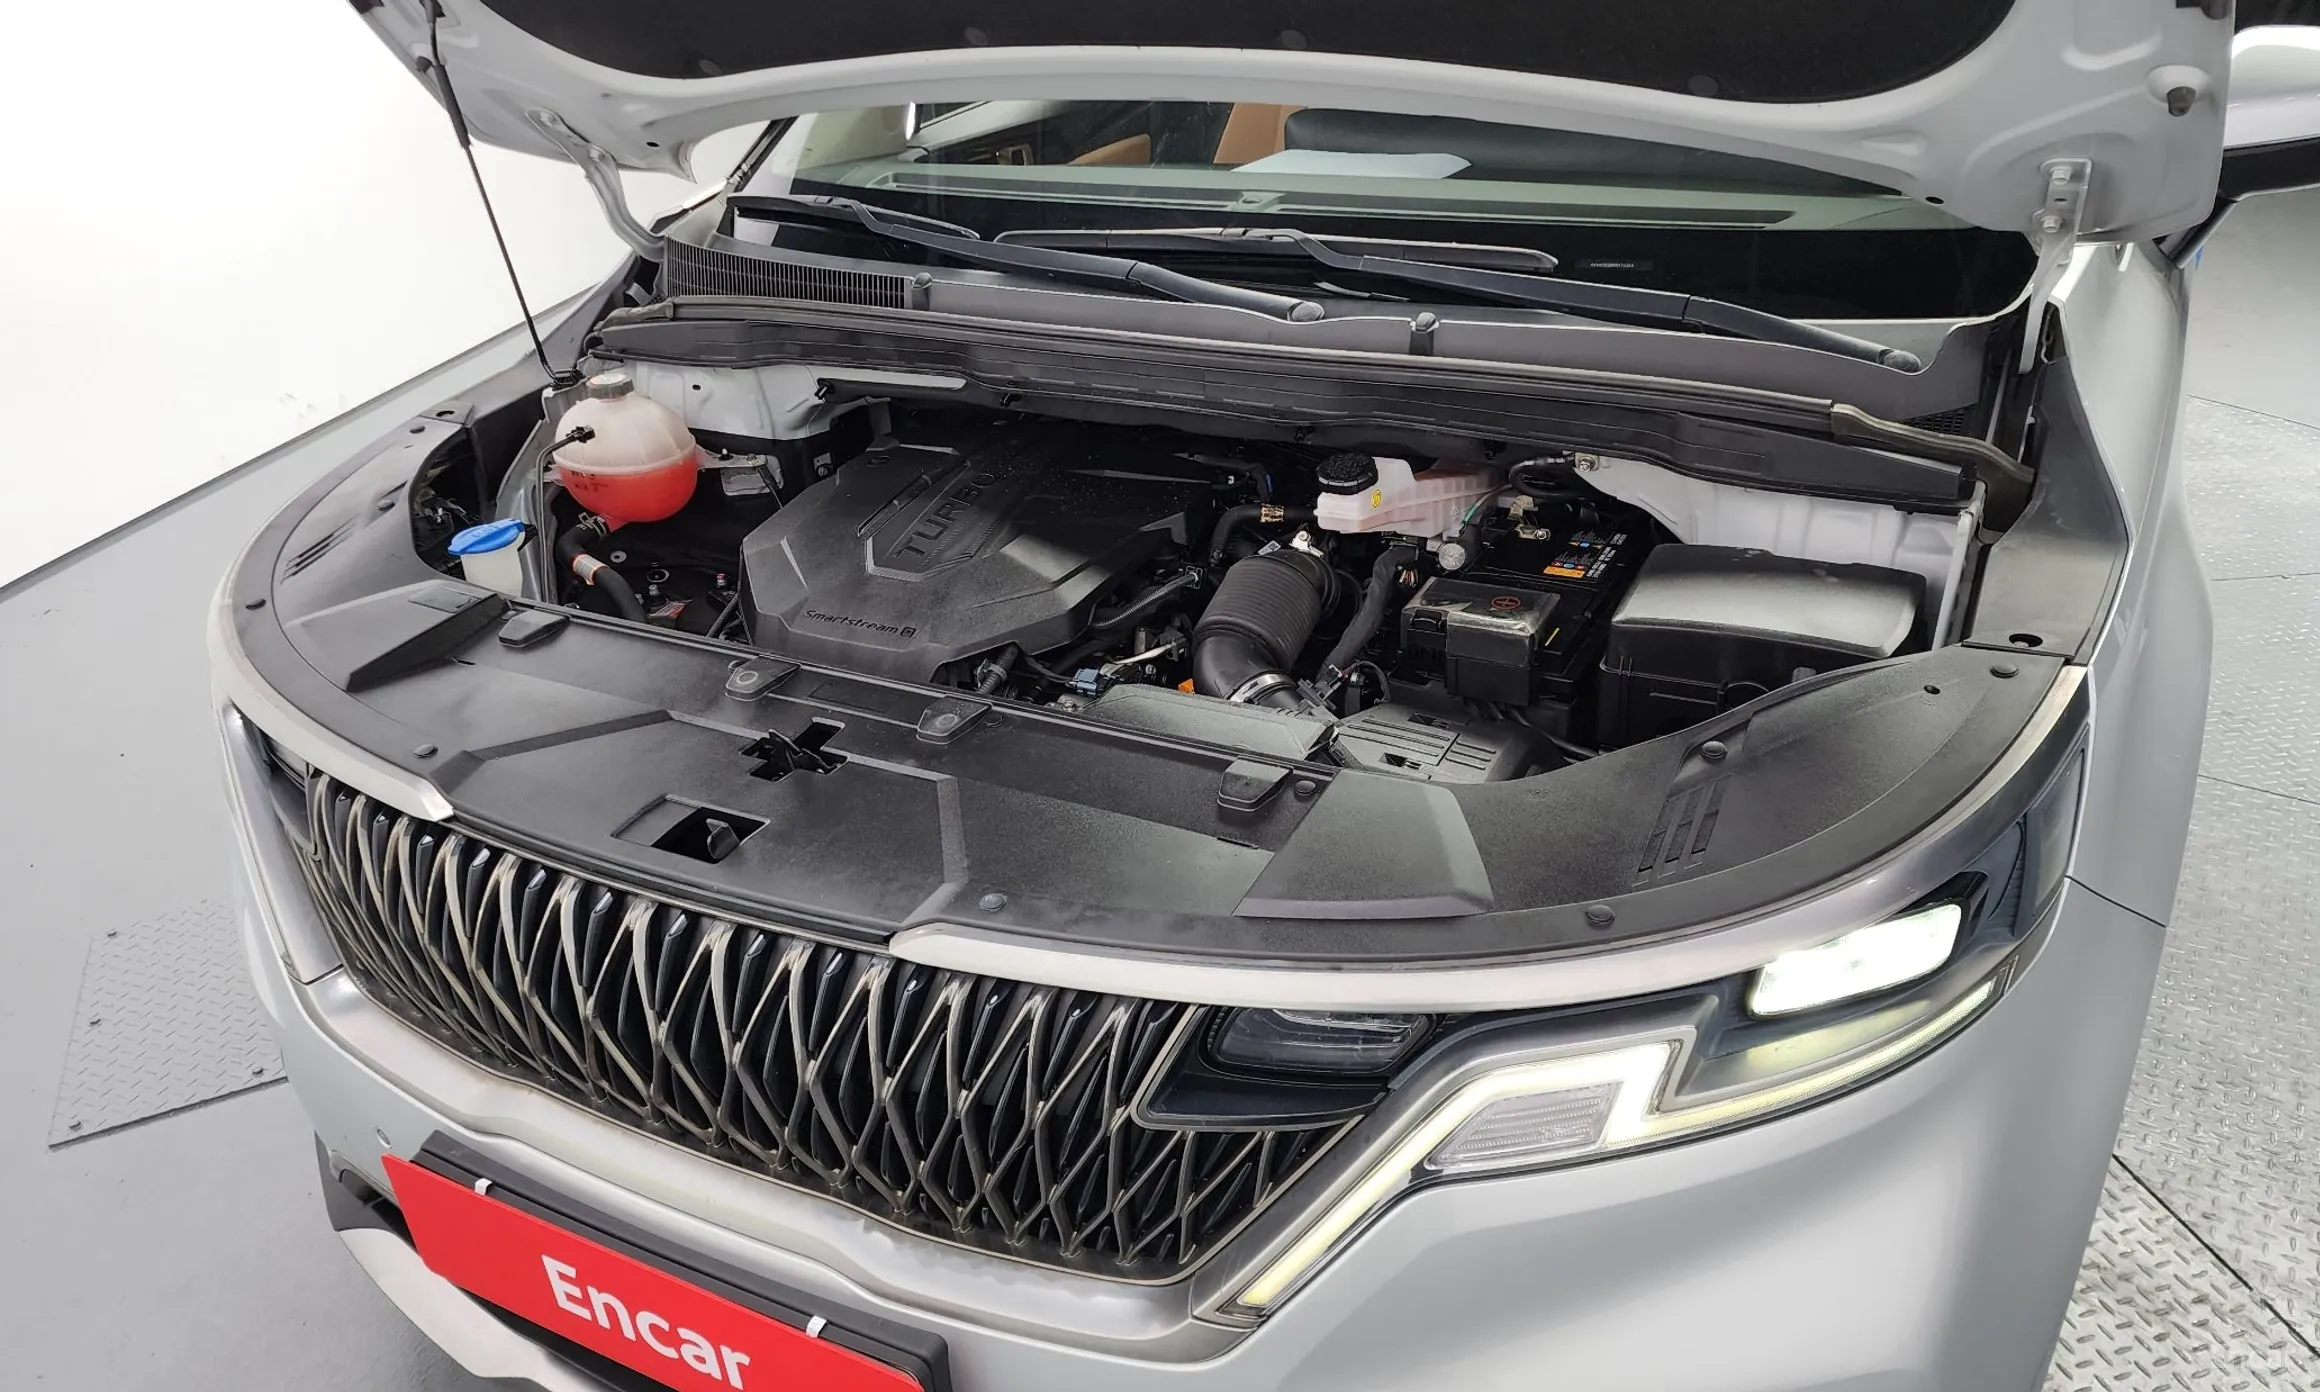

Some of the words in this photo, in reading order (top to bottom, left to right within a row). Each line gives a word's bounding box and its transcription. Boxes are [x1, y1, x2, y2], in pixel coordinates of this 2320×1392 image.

[893, 473, 996, 558] TURBO
[804, 609, 899, 635] Smartstream
[541, 1254, 751, 1391] Encar
